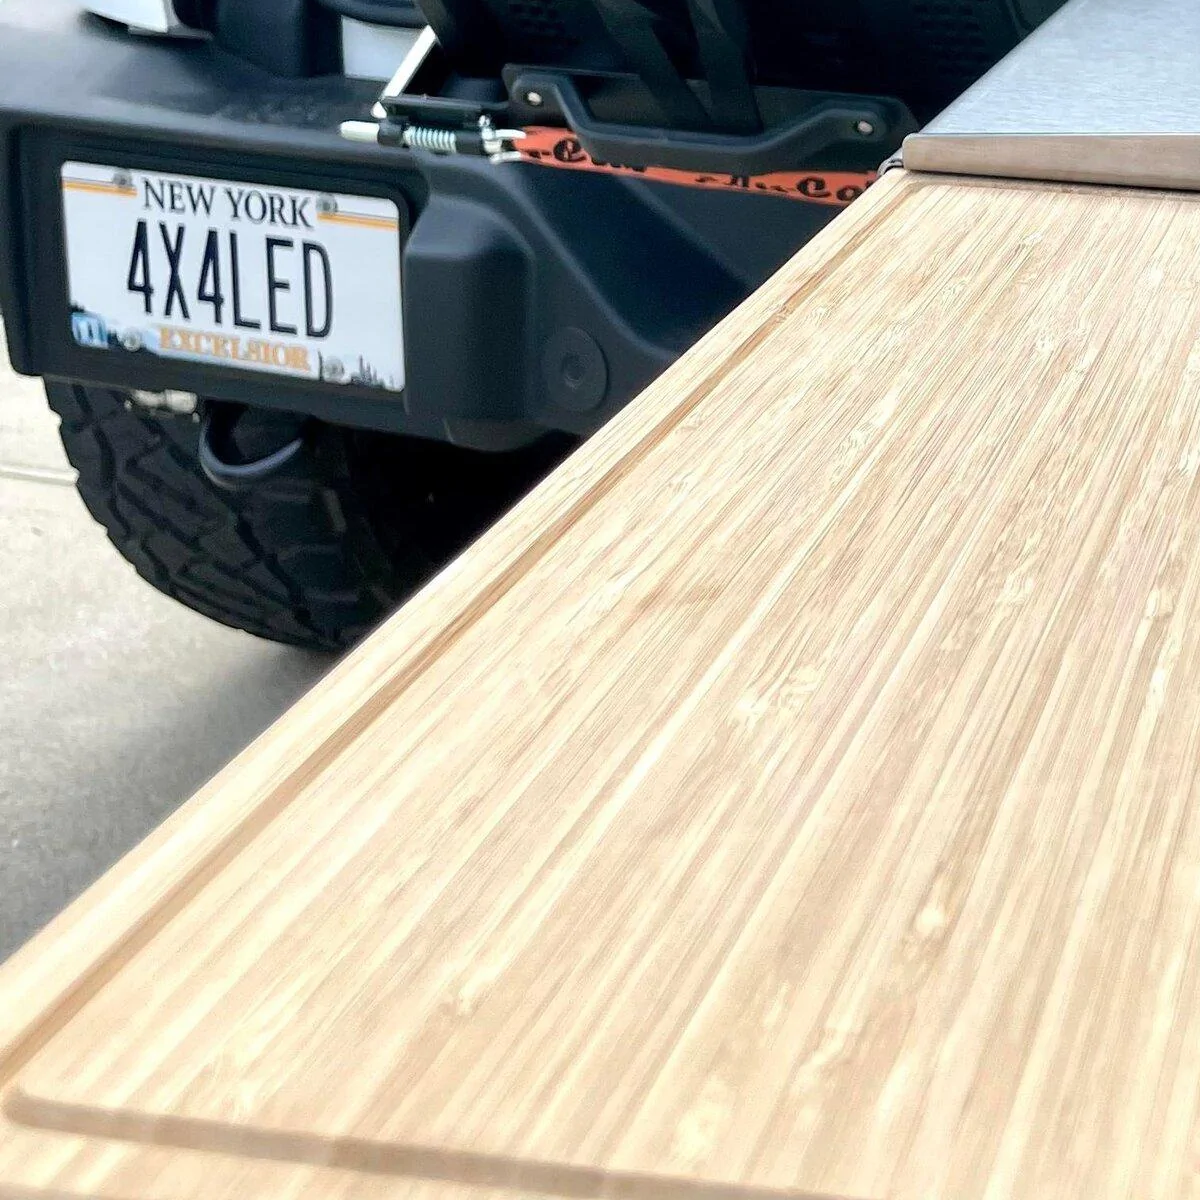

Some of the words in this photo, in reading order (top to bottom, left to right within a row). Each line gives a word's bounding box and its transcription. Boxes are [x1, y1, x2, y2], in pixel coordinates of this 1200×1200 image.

[143, 178, 216, 216] NEW
[224, 186, 315, 230] YORK
[127, 219, 333, 338] 4X4LED
[159, 326, 311, 373] EXCELSIOR
